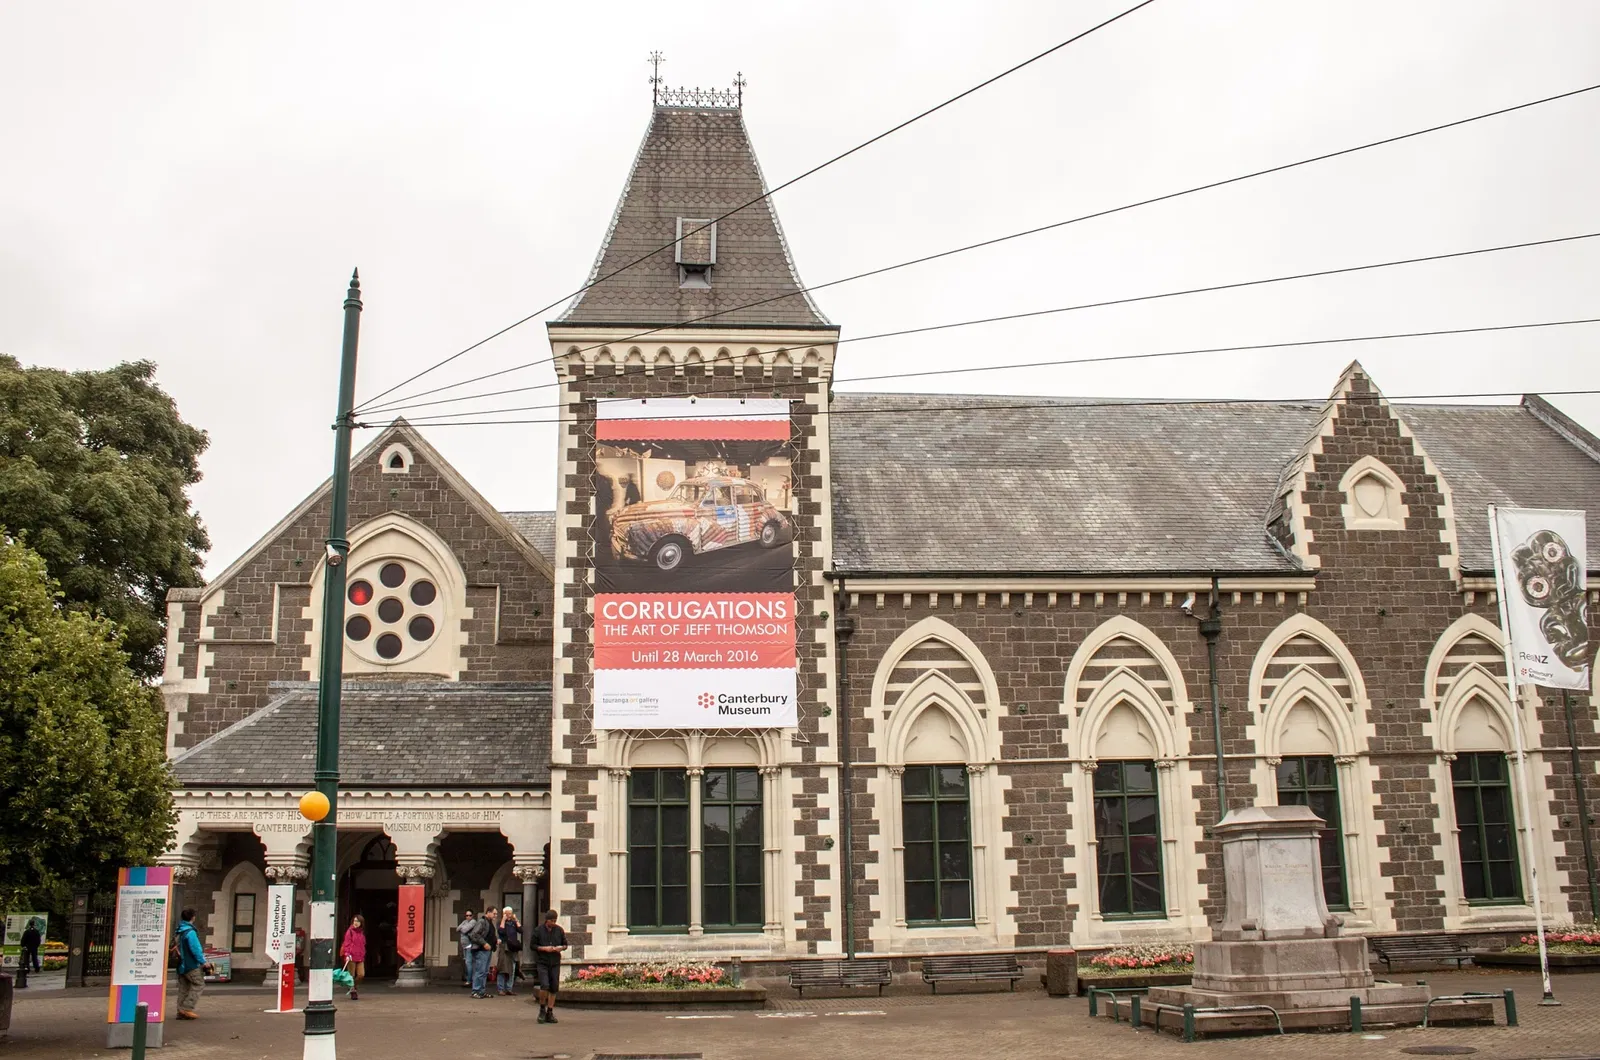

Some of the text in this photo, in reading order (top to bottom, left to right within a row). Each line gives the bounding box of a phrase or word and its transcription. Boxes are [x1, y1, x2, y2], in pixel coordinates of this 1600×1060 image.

[602, 600, 787, 620] CORRUGATIONS
[603, 623, 787, 636] THE ART OF JEFF THOMSON
[632, 650, 758, 663] Until 28 March 2016
[718, 693, 788, 705] Canterbury
[718, 705, 771, 715] Museum
[195, 811, 204, 820] LO
[207, 811, 231, 820] THESE
[233, 811, 248, 820] ARE
[250, 811, 274, 820] PARTS
[277, 811, 285, 820] OF
[288, 811, 302, 820] HIS
[483, 811, 500, 820] HIM
[255, 823, 440, 832] CANTERBURY MUSEUM 1870
[272, 894, 281, 938] Canterbury
[406, 905, 416, 932] open
